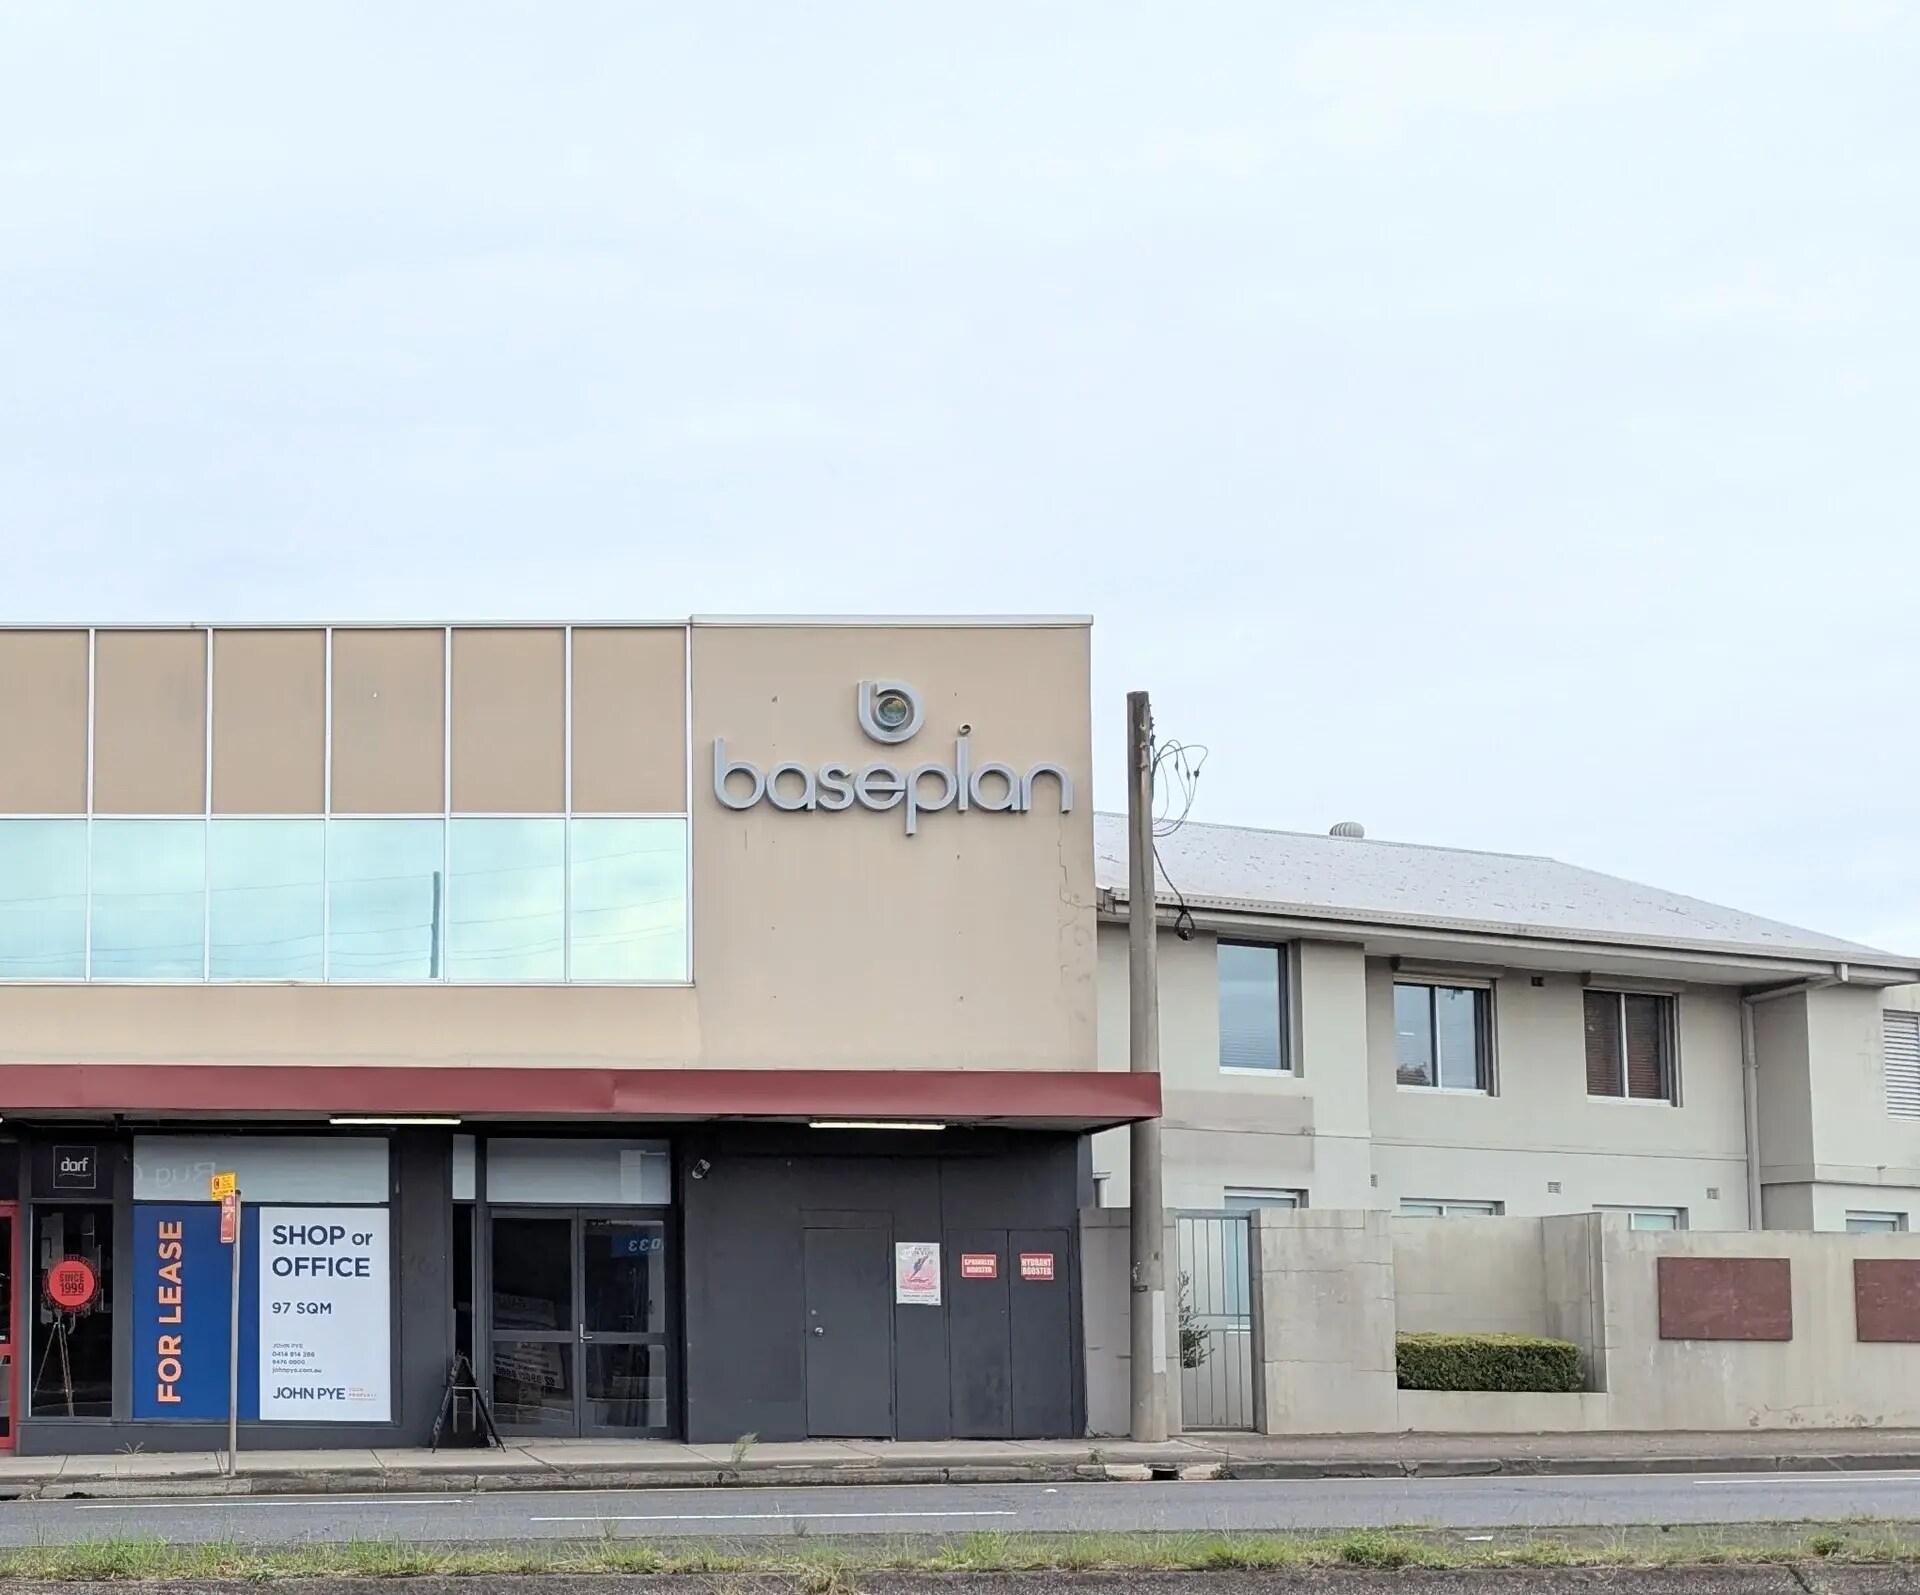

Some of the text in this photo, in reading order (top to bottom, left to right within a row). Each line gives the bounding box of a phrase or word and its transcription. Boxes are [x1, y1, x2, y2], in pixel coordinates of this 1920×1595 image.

[713, 735, 1074, 836] baseplan
[272, 1224, 373, 1246] SHOP or
[272, 1256, 370, 1278] OFFICE
[60, 1282, 85, 1294] 1999
[157, 1221, 182, 1403] FOR LEASE
[272, 1302, 332, 1315] 97 SQM
[273, 1387, 345, 1400] JOHN PYE
